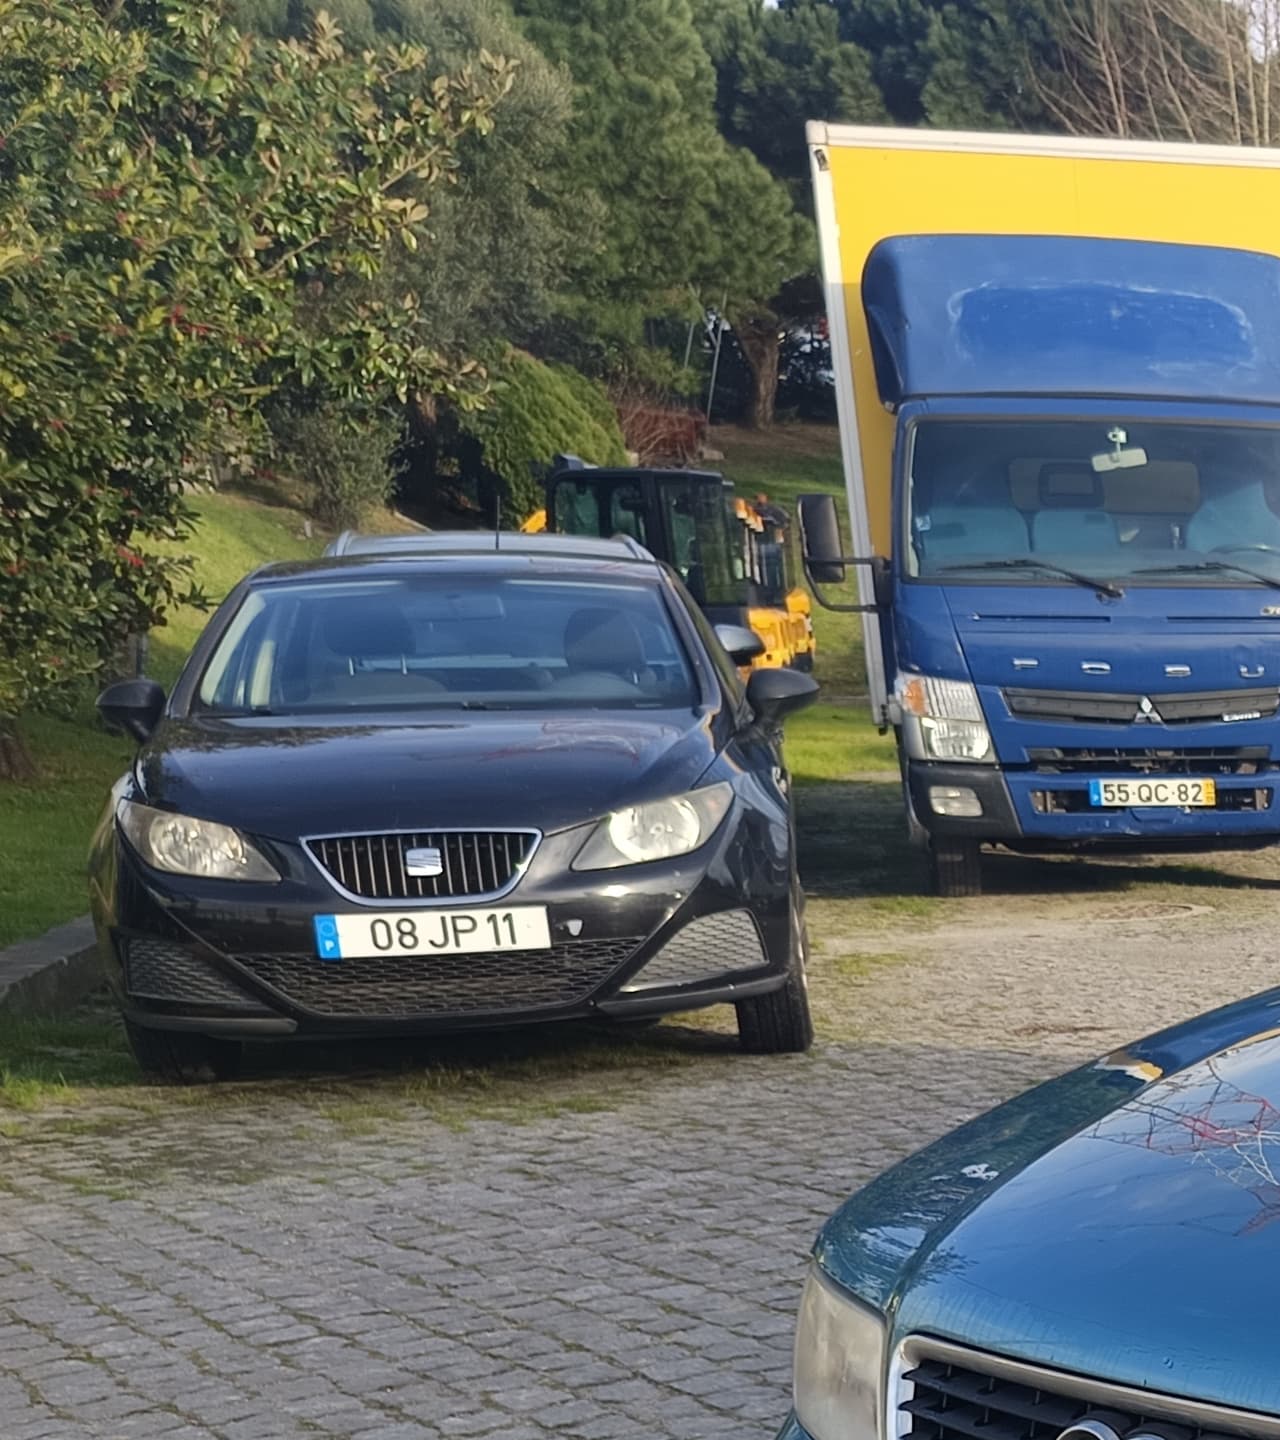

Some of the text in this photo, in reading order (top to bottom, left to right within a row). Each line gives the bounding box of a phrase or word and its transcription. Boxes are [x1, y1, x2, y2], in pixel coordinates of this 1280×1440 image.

[370, 913, 517, 951] 08 JP 11
